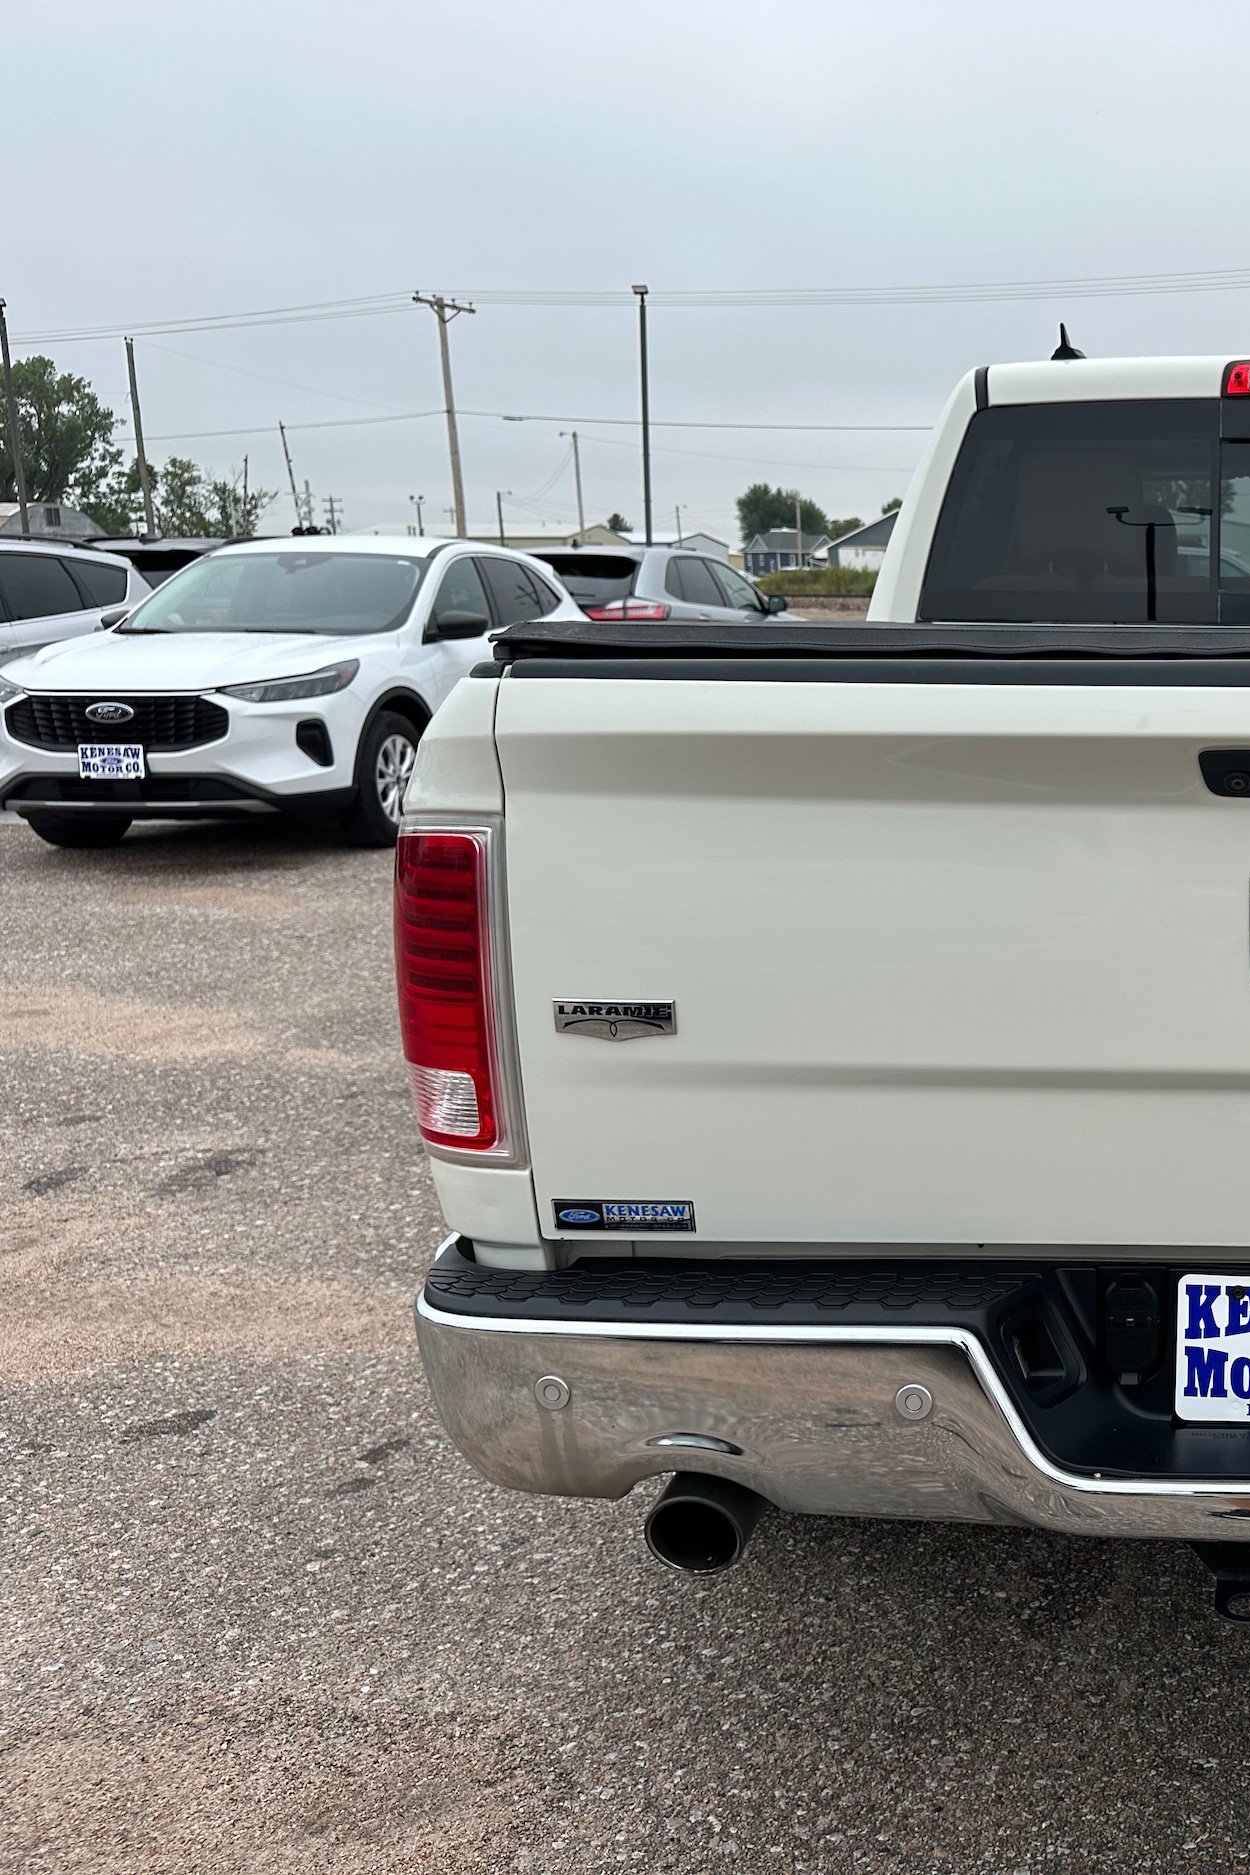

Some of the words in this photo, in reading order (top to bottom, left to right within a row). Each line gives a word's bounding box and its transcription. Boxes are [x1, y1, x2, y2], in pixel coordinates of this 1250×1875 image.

[95, 706, 122, 720] Ford
[80, 747, 140, 759] KENESAW
[81, 761, 123, 773] MOTOR
[558, 1004, 670, 1018] LARAMIE
[568, 1210, 592, 1220] Ford
[605, 1205, 687, 1217] KENESAW
